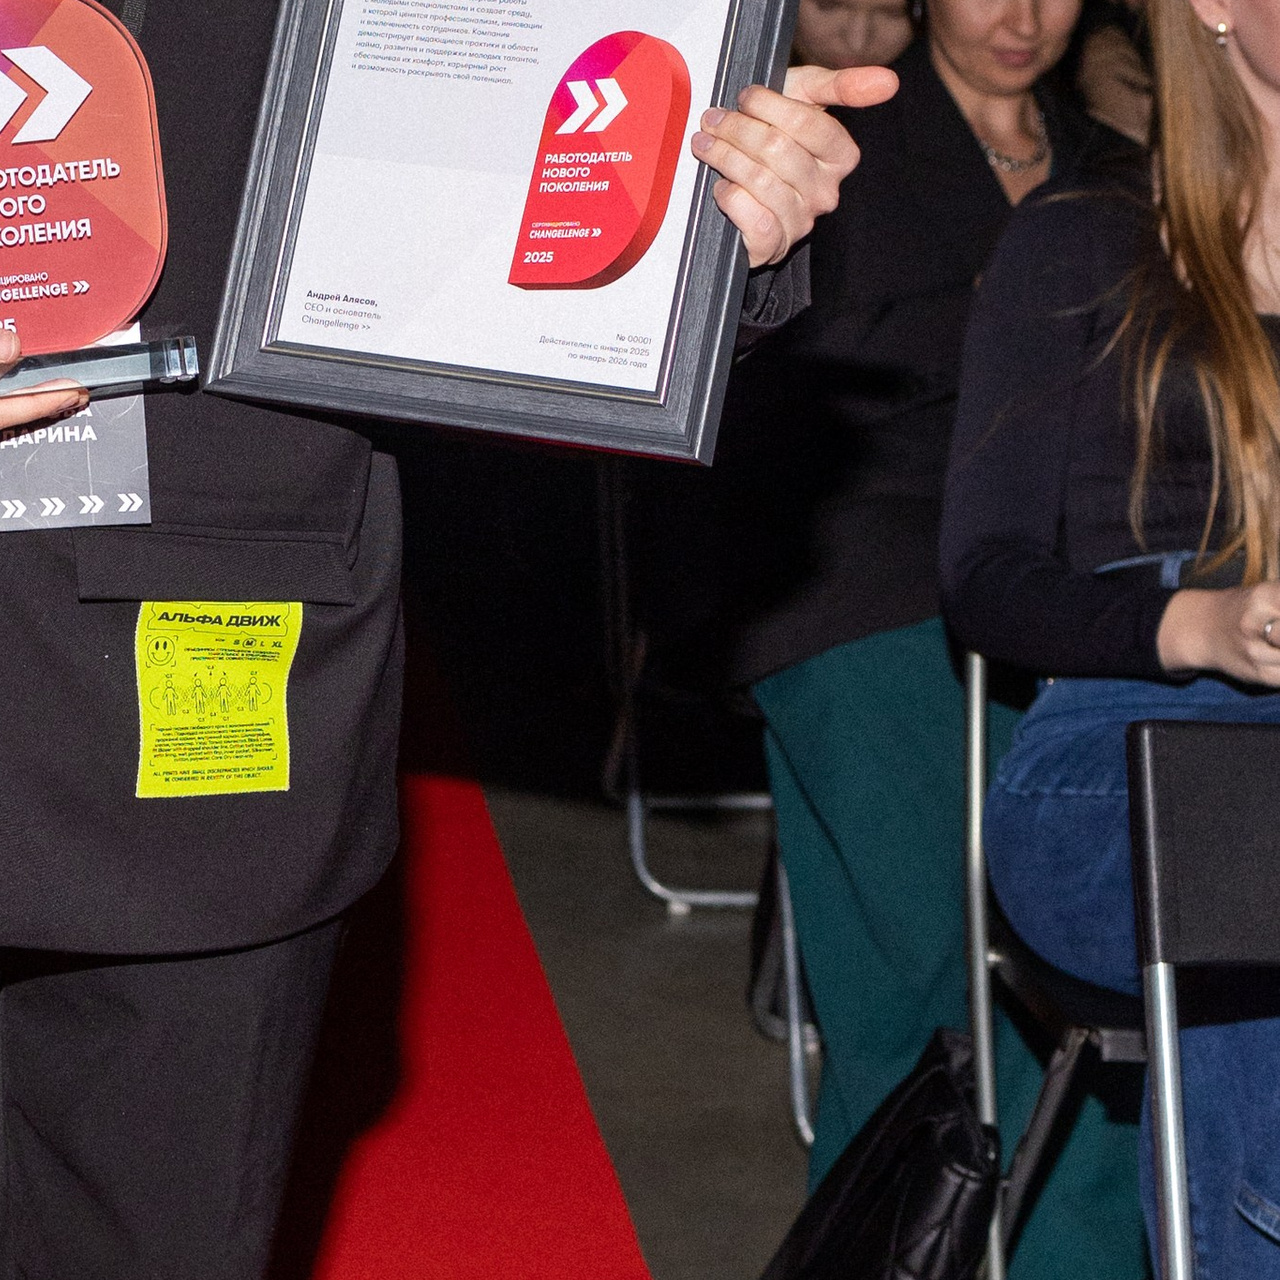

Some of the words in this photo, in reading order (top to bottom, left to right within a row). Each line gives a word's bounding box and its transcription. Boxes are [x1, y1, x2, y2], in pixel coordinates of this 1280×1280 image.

[545, 151, 632, 164] РАБОТОДАТЕЛЬ
[542, 167, 590, 178] НОВОГО
[539, 181, 609, 193] ПОКОЛЕНИЯ
[529, 228, 590, 239] CHANGELLENGE
[523, 252, 554, 263] 2025
[307, 290, 340, 301] Андрей
[343, 295, 377, 307] Алясов,
[304, 302, 324, 312] CEO
[333, 308, 381, 319] основатель
[302, 315, 359, 331] Changellenge
[539, 335, 592, 348] Действителен
[600, 345, 628, 354] января
[630, 347, 649, 356] 2025
[628, 335, 651, 344] 00001
[579, 355, 606, 363] январь
[608, 356, 628, 365] 2026
[0, 425, 97, 449] ДАРИНА
[158, 612, 223, 625] АЛЬФА
[226, 615, 281, 627] ДВИЖ
